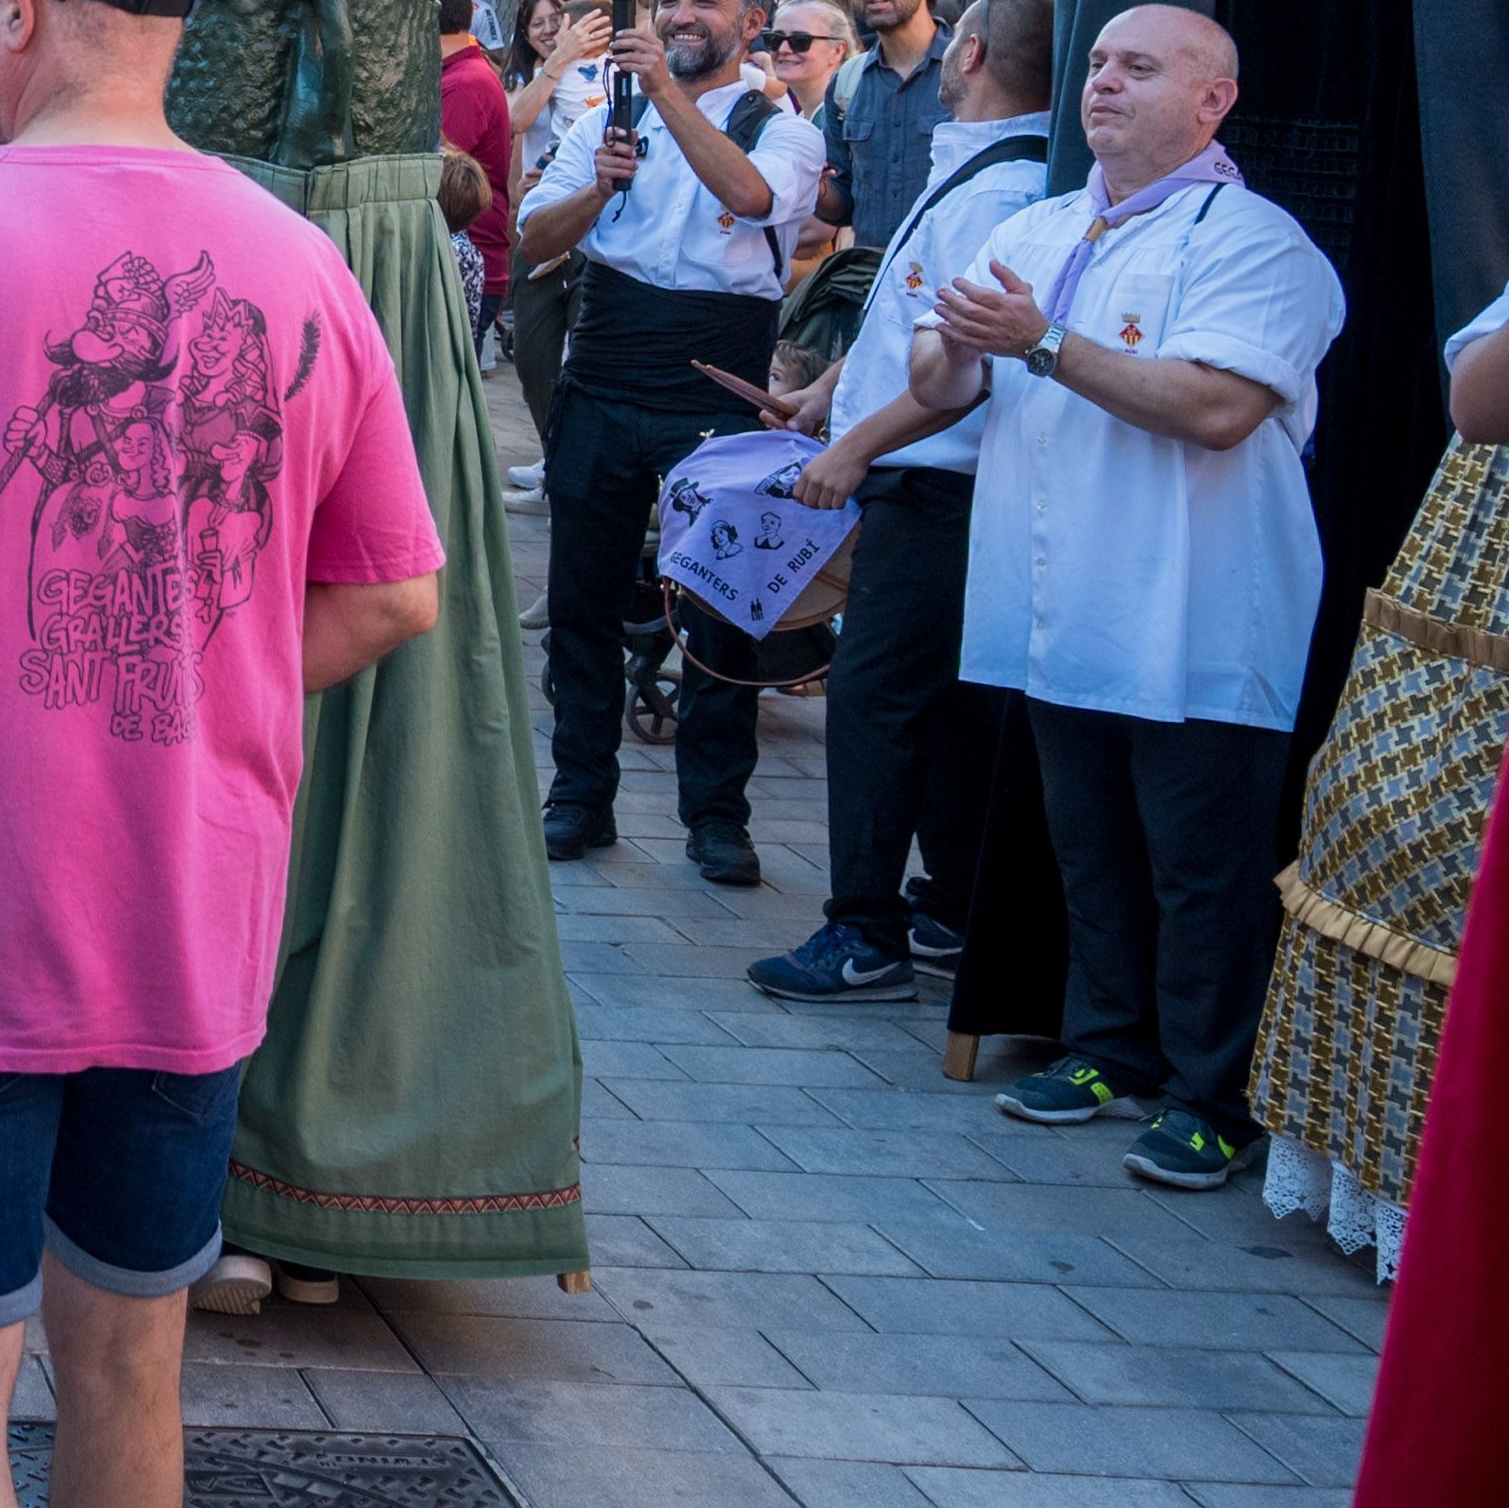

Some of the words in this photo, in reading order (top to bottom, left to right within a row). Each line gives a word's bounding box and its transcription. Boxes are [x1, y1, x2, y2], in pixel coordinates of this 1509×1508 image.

[767, 573, 788, 594] DE
[787, 537, 821, 574] RUBÍ
[19, 647, 110, 711] SANT
[111, 713, 144, 742] DE
